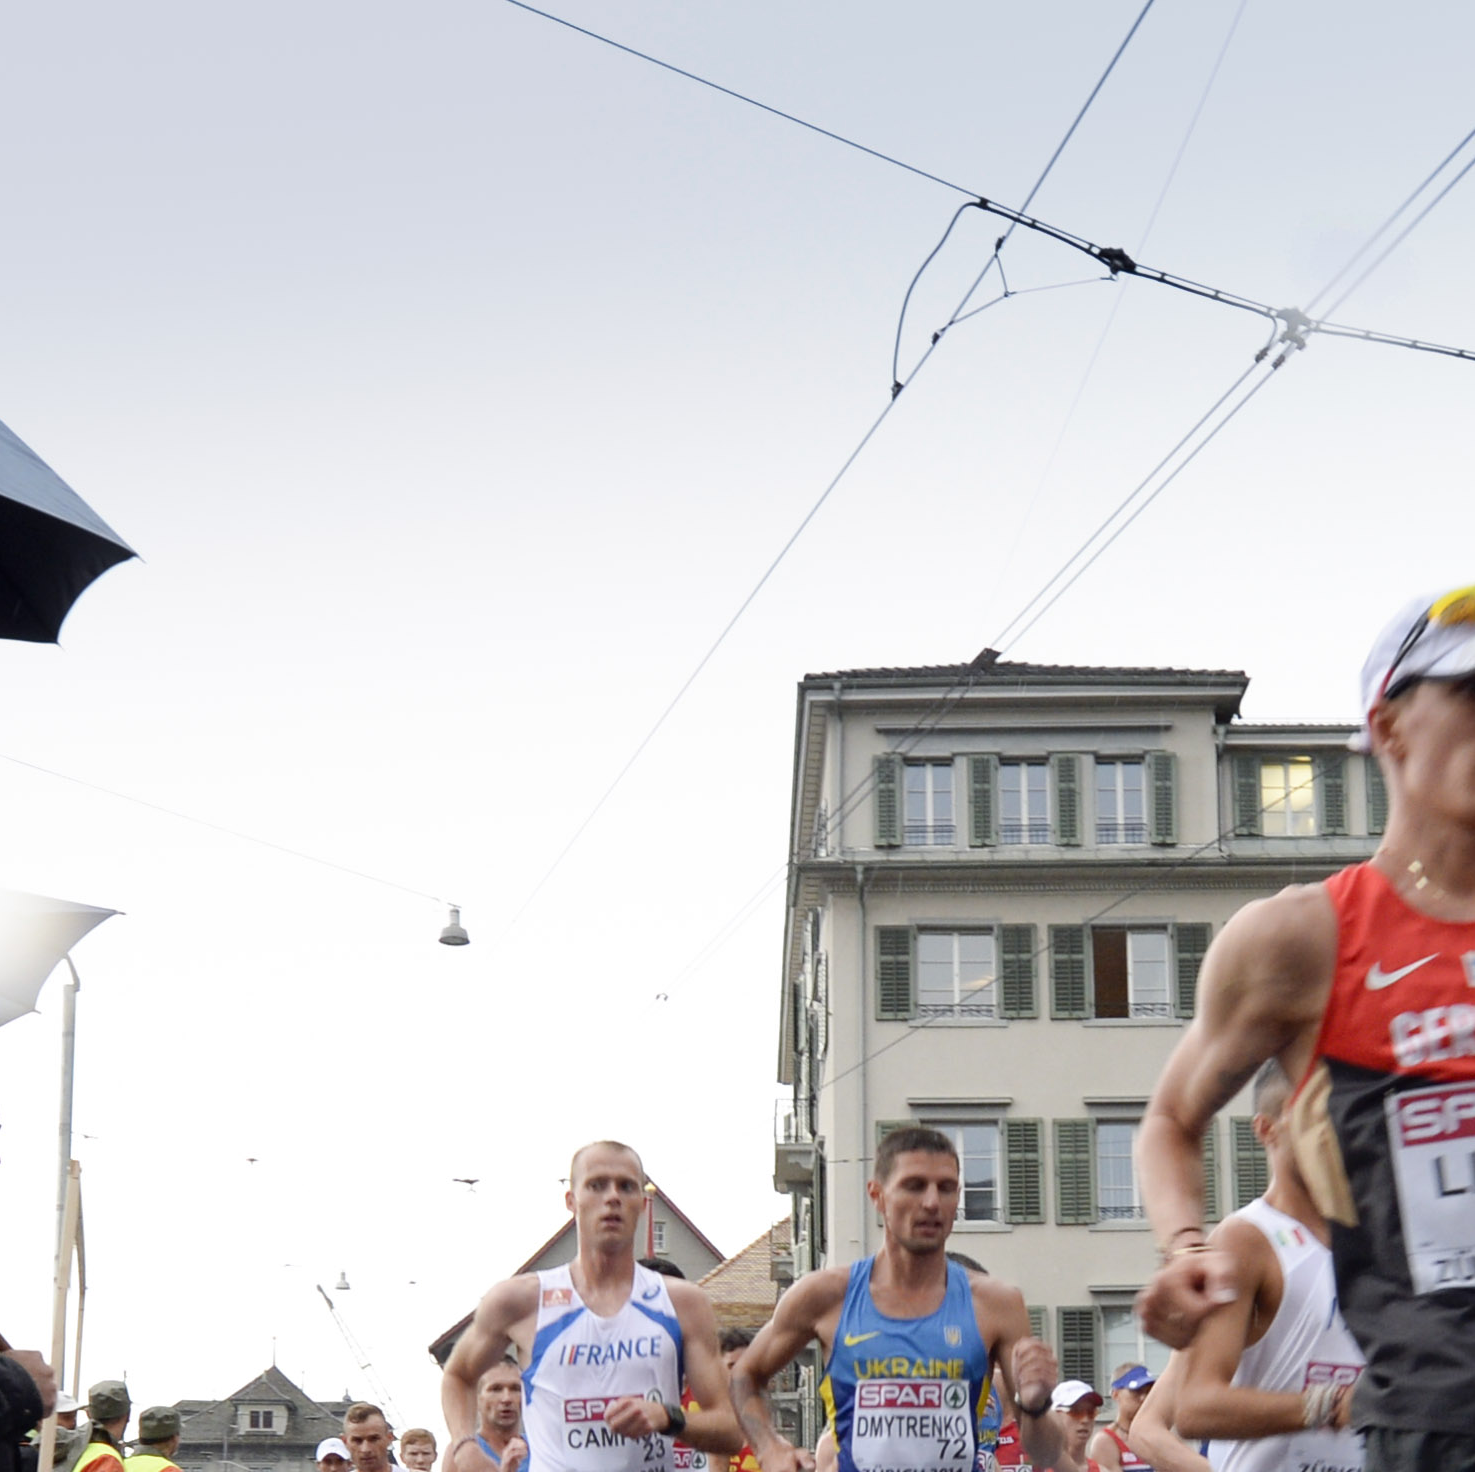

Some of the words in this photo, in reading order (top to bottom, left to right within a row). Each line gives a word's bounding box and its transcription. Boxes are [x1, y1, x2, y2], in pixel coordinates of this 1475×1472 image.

[573, 1336, 662, 1366] FRANCE
[853, 1356, 964, 1379] UKRAINE
[859, 1385, 941, 1407] SPAR
[856, 1415, 968, 1438] DMYTRENKO
[643, 1438, 666, 1462] 23
[937, 1438, 967, 1460] 72
